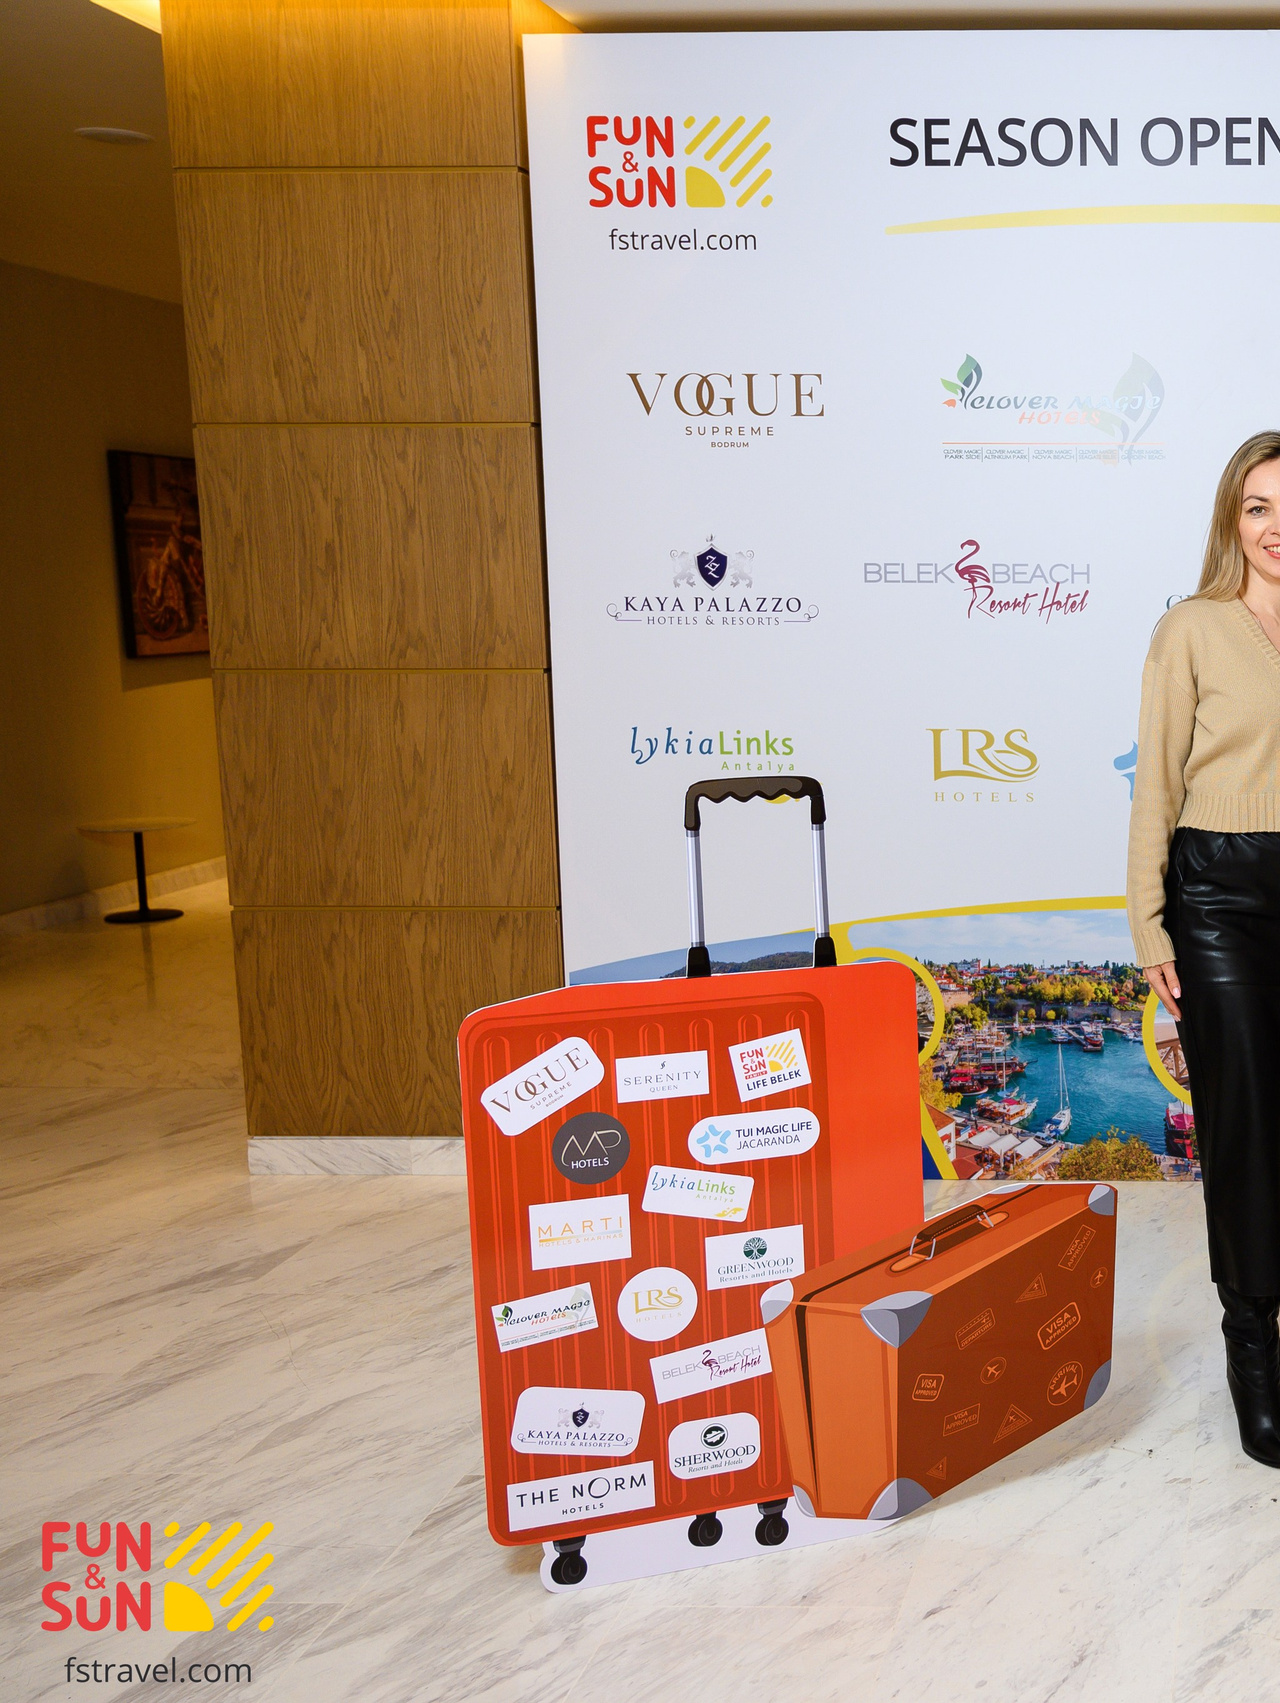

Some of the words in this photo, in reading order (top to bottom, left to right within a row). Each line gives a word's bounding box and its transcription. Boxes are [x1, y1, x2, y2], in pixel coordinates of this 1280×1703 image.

[586, 115, 674, 158] FUN
[888, 116, 1118, 167] SEASON
[622, 151, 639, 173] &
[588, 165, 676, 208] SUN
[608, 228, 757, 250] fstravel.com
[626, 372, 825, 417] VOGUE
[970, 395, 1059, 410] CLOVER
[685, 425, 774, 436] SUPREME
[864, 562, 956, 583] BELEK
[991, 562, 1091, 585] BEACH
[624, 596, 685, 613] KAYA
[694, 596, 802, 613] PALAZZO
[964, 585, 1038, 619] Resort
[1038, 582, 1089, 624] Hotel
[646, 616, 699, 625] HOTELS
[704, 616, 715, 625] &
[721, 616, 780, 626] RESORTS
[926, 728, 1040, 782] LRS
[721, 761, 796, 773] Antalya
[934, 791, 1035, 803] HOTELS
[739, 1047, 764, 1063] FUN
[742, 1059, 767, 1074] SUN
[490, 1047, 589, 1113] VOGUE
[623, 1070, 701, 1086] SERENITY
[746, 1078, 768, 1091] LIFE
[770, 1069, 802, 1085] BELEK
[530, 1081, 572, 1110] SUPREME
[649, 1084, 679, 1093] QUEEN
[736, 1129, 754, 1138] TUI
[756, 1124, 789, 1136] MAGIC
[791, 1121, 812, 1132] LIFE
[736, 1134, 801, 1150] JACARANDA
[571, 1157, 610, 1169] HOTELS
[538, 1216, 623, 1239] MARTI
[538, 1238, 572, 1248] HOTELS
[584, 1233, 623, 1243] MARINAS
[717, 1256, 794, 1275] GREENWOOD
[719, 1273, 749, 1283] Resorts
[751, 1271, 766, 1279] and
[768, 1267, 793, 1276] Hotels
[632, 1286, 684, 1315] LRS
[635, 1312, 682, 1323] HOTELS
[1046, 1312, 1071, 1334] VISA
[961, 1321, 993, 1347] DEPARTURE
[1045, 1316, 1077, 1345] APPROVED
[662, 1363, 703, 1380] BELEK
[718, 1345, 761, 1364] BEACH
[921, 1379, 937, 1388] VISA
[1049, 1363, 1078, 1390] ARRIVAL
[527, 1430, 560, 1440] KAYA
[566, 1431, 625, 1442] PALAZZO
[674, 1444, 756, 1468] SHERWOOD
[688, 1463, 709, 1474] Resorts
[710, 1461, 723, 1469] and
[724, 1458, 743, 1467] Hotels
[516, 1488, 559, 1508] THE
[572, 1473, 647, 1498] NORM
[562, 1502, 605, 1515] HOTELS
